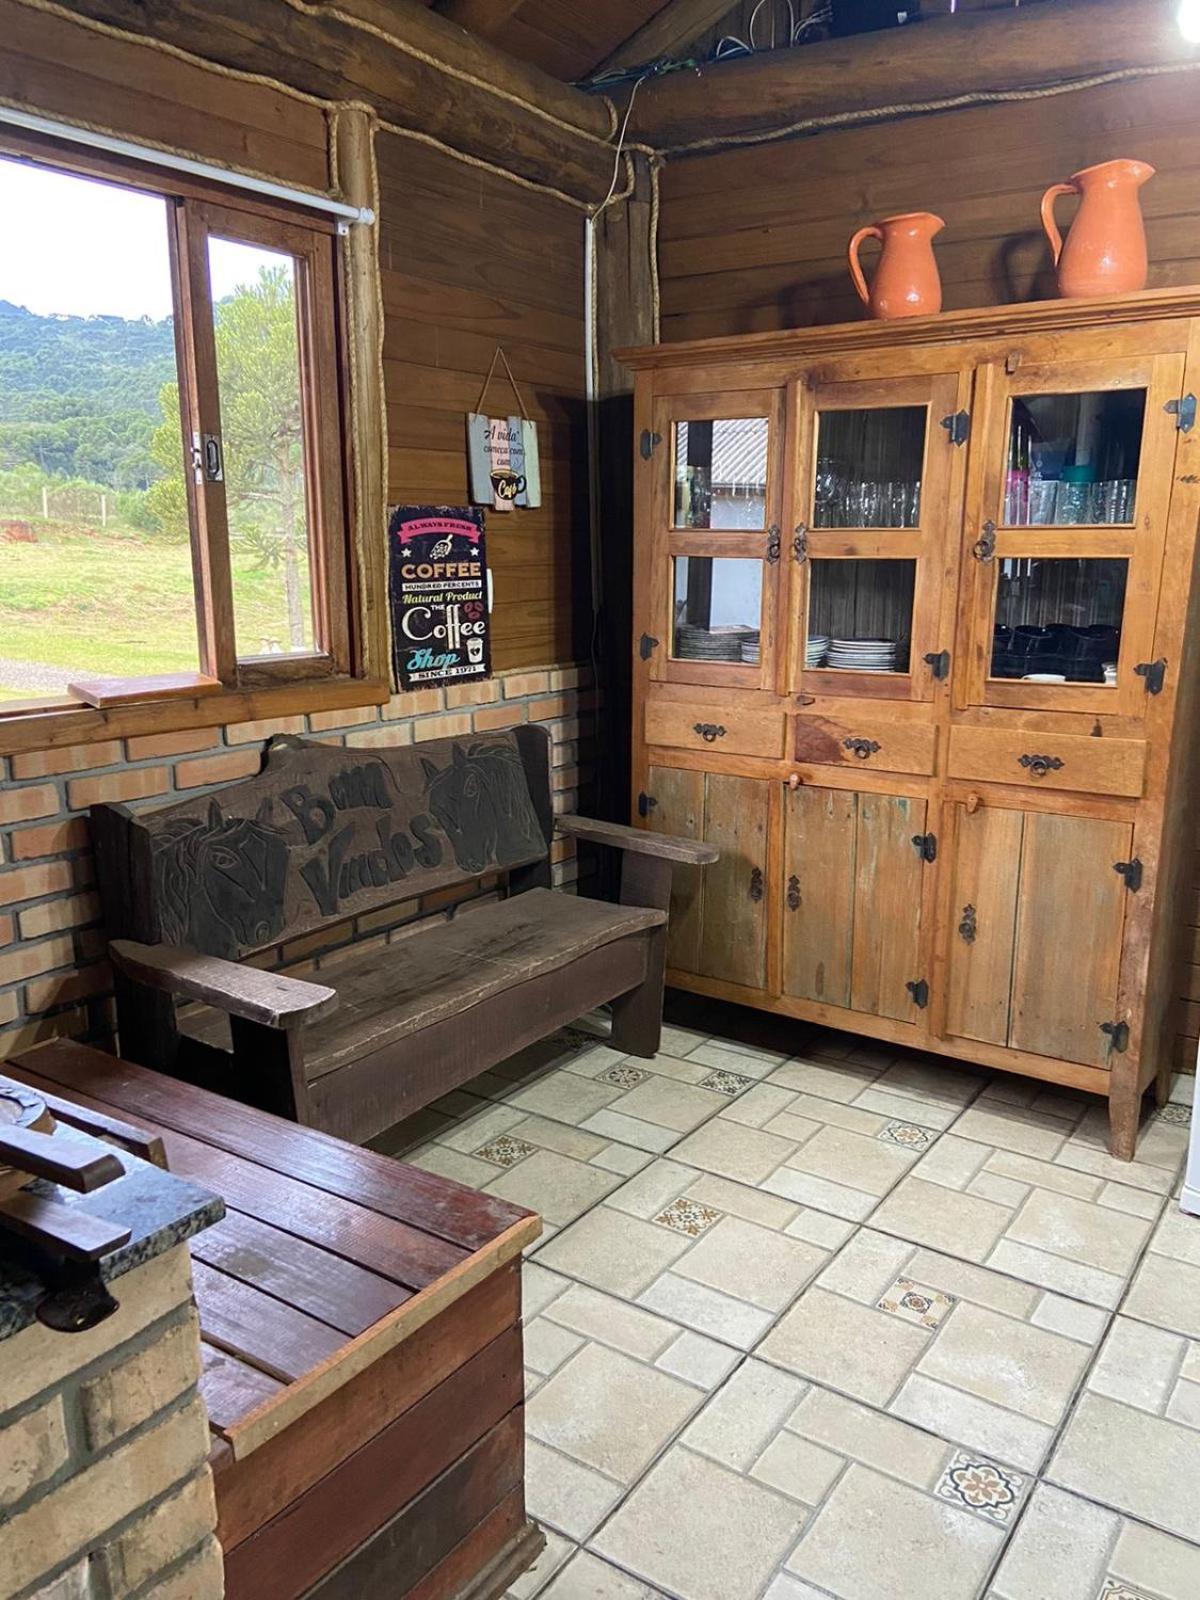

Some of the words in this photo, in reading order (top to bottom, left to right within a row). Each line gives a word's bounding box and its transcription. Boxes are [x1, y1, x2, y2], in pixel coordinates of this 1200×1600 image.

[484, 425, 496, 440] A
[497, 427, 519, 442] vida
[407, 521, 442, 531] ALWAYS
[443, 521, 473, 531] FRESH
[401, 562, 481, 579] COFFEE
[404, 582, 442, 591] HUNDRED
[443, 580, 480, 589] PERCENTS
[401, 592, 443, 604] Natural
[445, 591, 482, 602] Product
[401, 604, 486, 650] Coffee
[406, 647, 461, 671] Shop
[418, 669, 452, 678] SINCE
[299, 811, 444, 917] Vindos
